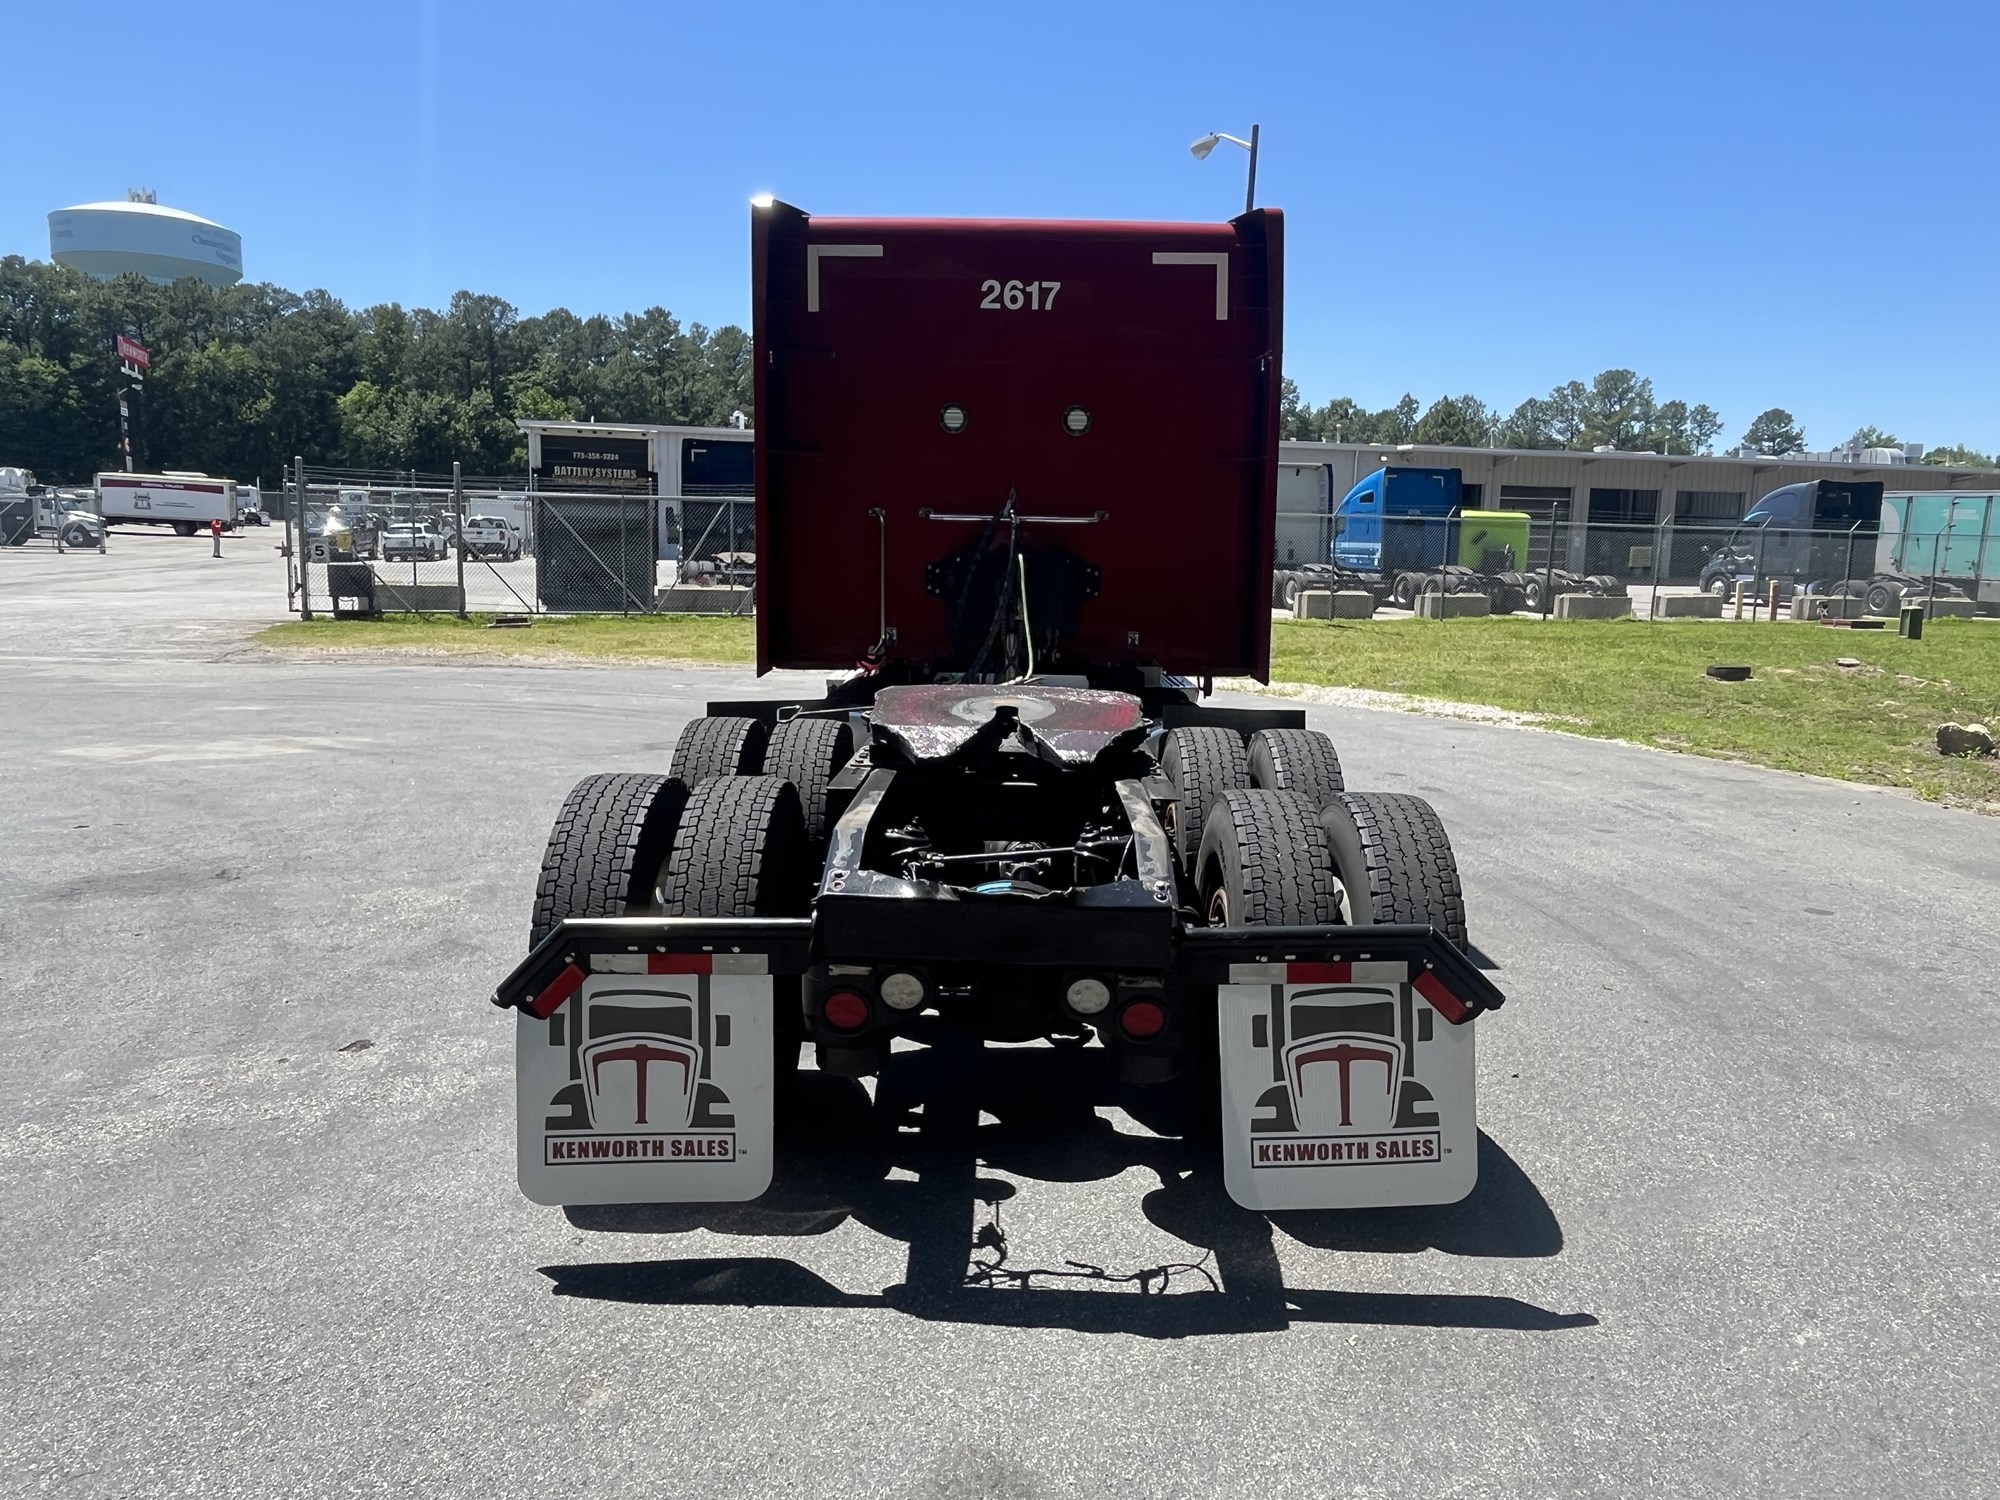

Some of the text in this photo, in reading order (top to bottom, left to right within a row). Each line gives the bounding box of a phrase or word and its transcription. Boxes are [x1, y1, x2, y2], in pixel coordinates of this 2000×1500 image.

[980, 279, 1061, 310] 2617
[554, 465, 637, 479] BATTERY SYSTEMS
[315, 545, 324, 556] 5
[552, 1140, 664, 1159] KENWORTH
[671, 1139, 729, 1157] SALES
[1259, 1142, 1369, 1162] KENWORTH
[1375, 1139, 1434, 1158] SALES
